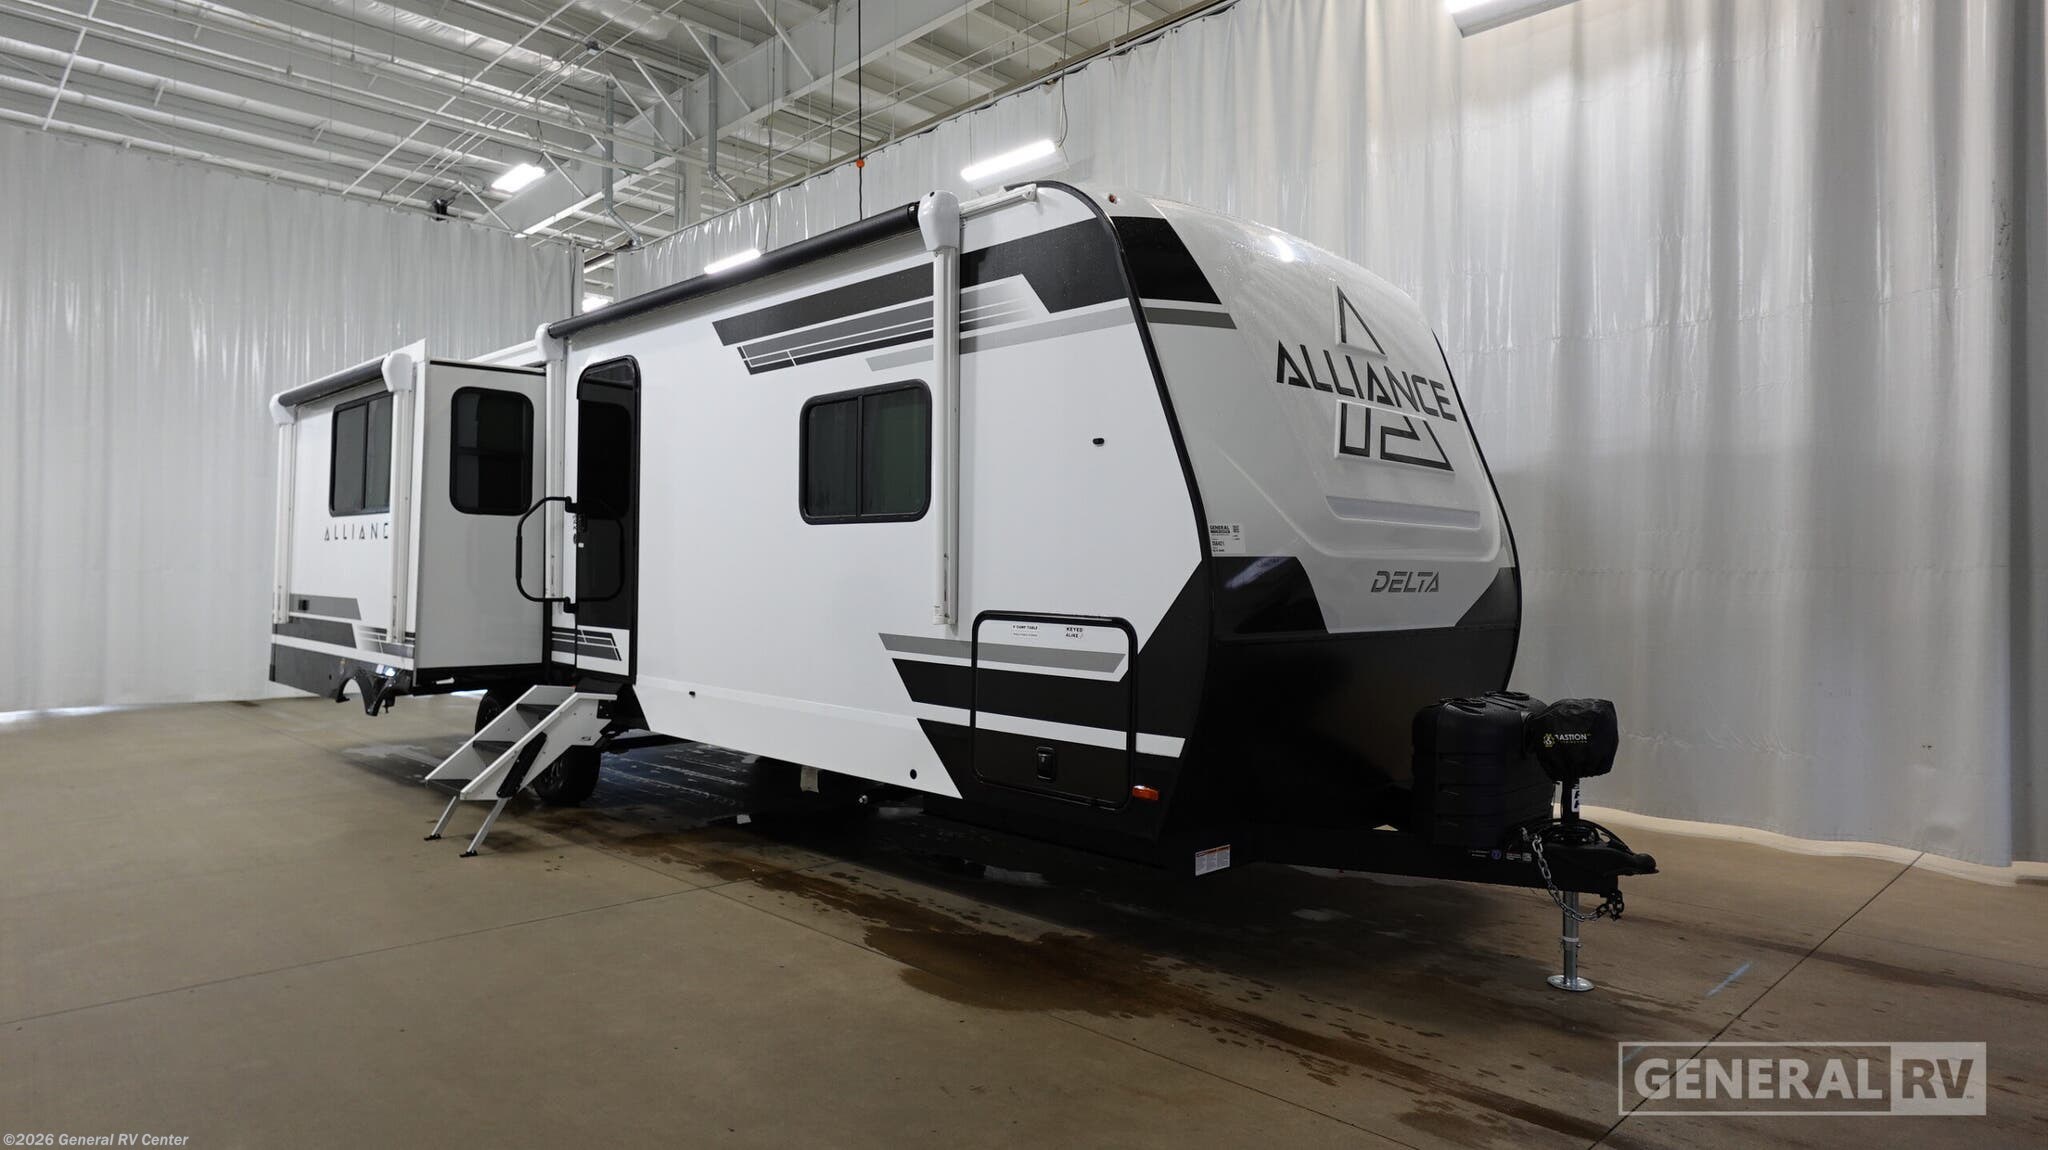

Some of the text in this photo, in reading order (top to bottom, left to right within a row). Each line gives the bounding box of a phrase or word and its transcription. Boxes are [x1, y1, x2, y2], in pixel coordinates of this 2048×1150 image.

[1276, 339, 1458, 422] ALLIANCE
[323, 522, 389, 541] ALLIANC
[1371, 570, 1440, 593] DELTA
